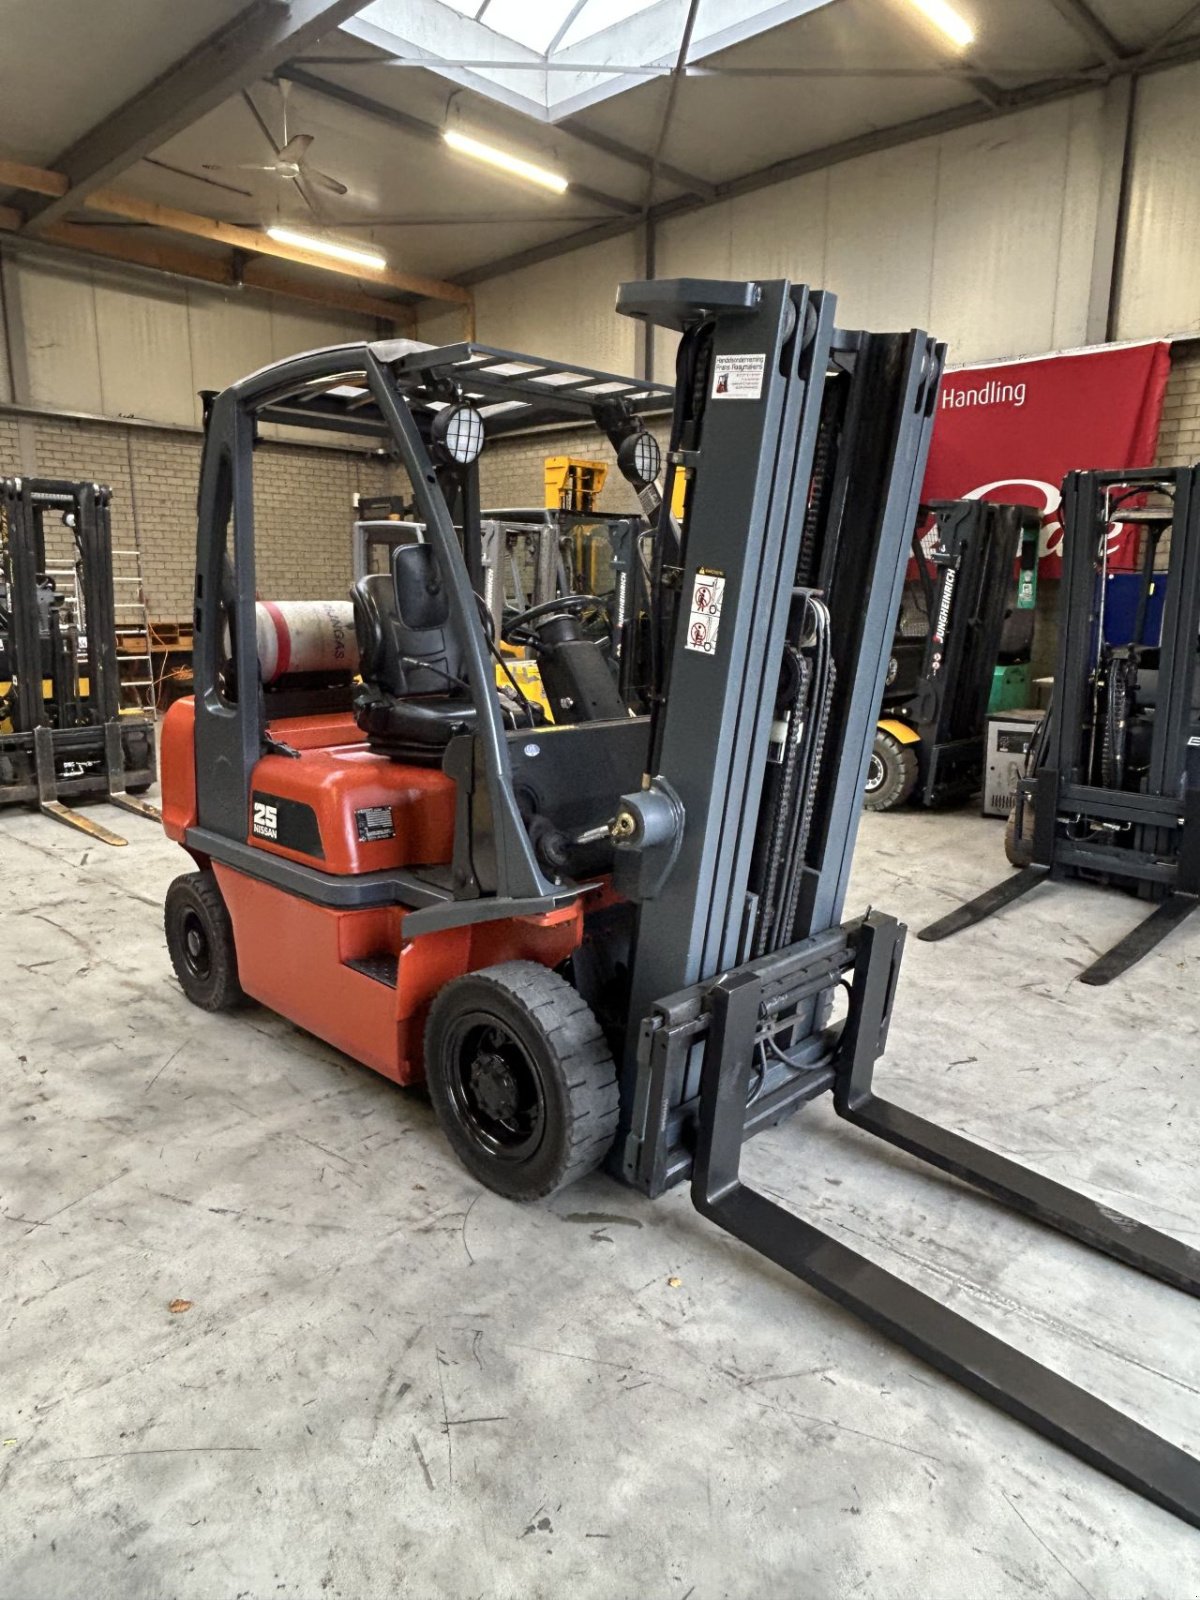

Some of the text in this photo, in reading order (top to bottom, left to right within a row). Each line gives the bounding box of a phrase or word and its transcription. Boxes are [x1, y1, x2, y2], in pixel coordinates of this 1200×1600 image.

[941, 382, 1026, 409] Handling
[935, 568, 956, 643] JUNGHEINRICH
[254, 802, 278, 829] 25
[254, 823, 278, 839] NISSAN
